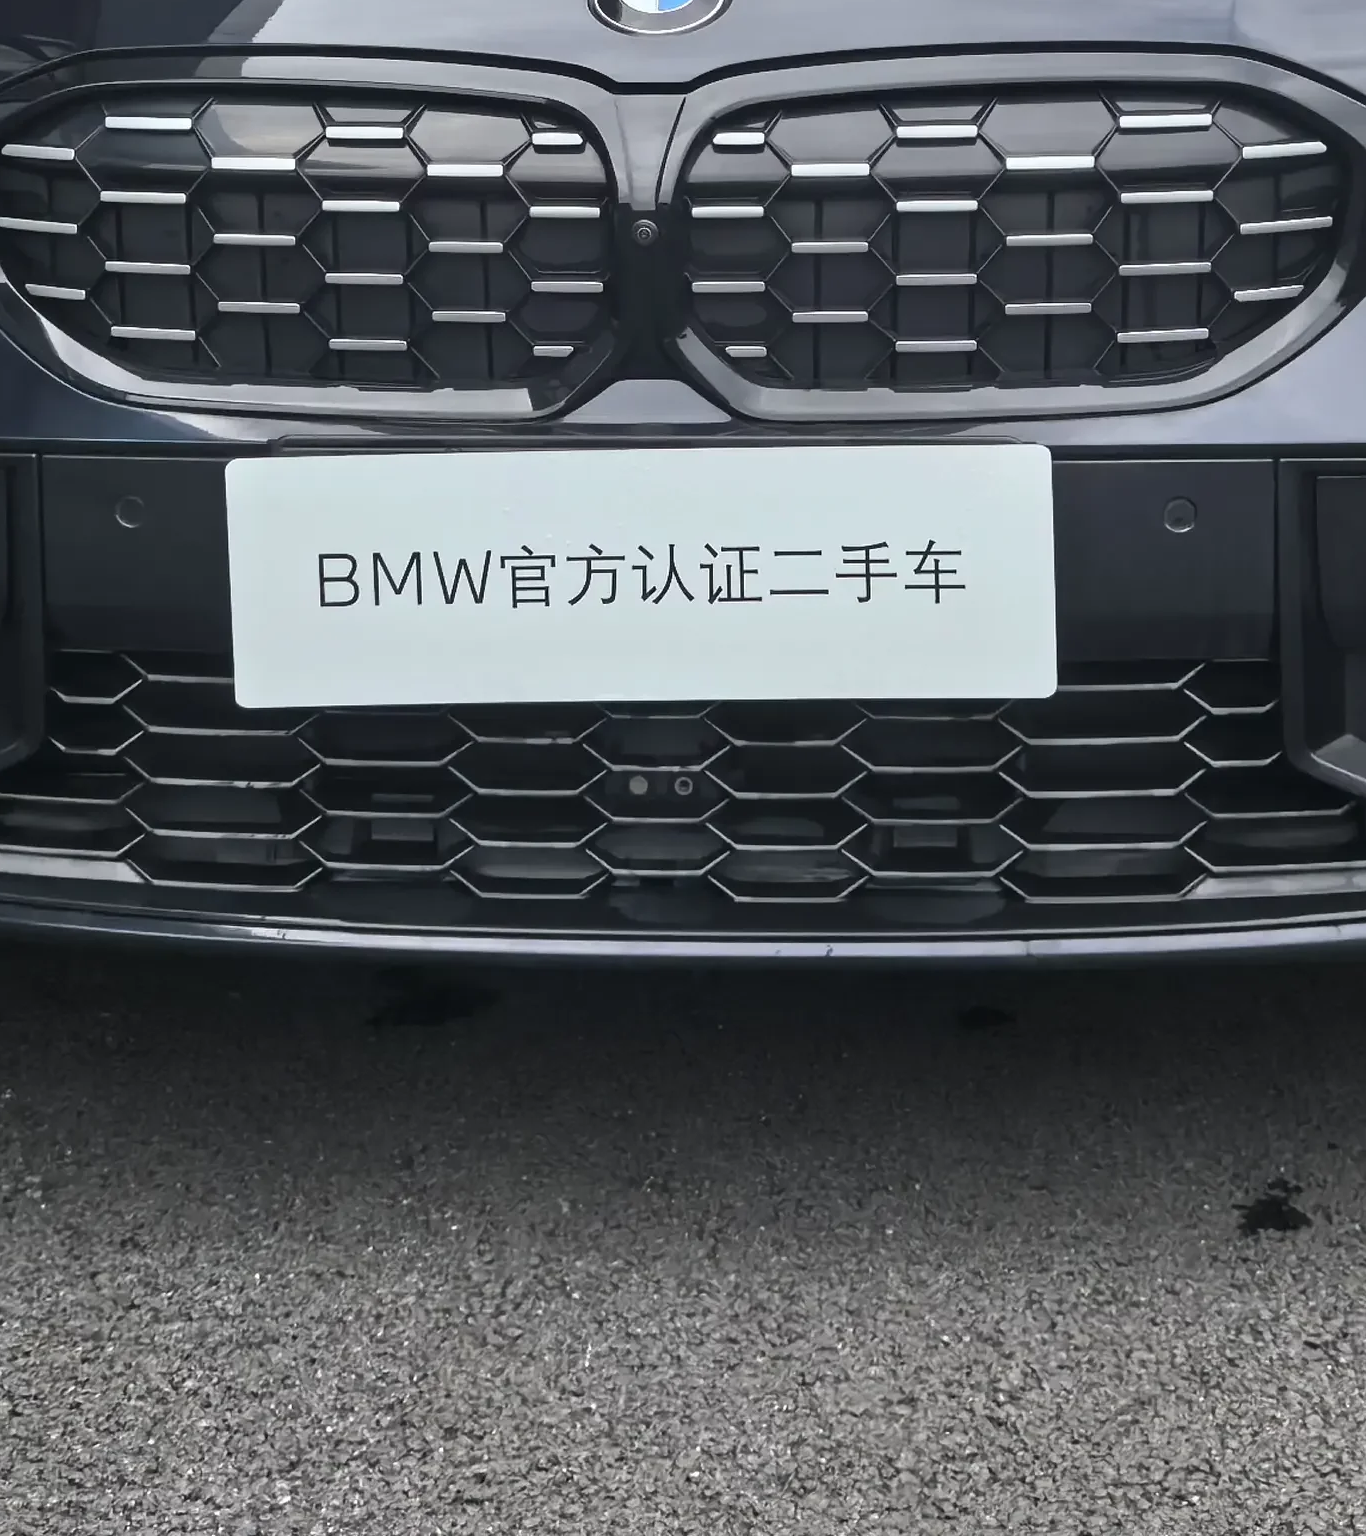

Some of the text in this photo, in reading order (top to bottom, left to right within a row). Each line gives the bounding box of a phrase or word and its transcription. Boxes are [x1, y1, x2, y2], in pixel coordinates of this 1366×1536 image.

[318, 539, 966, 609] BMW官方认证二手车
